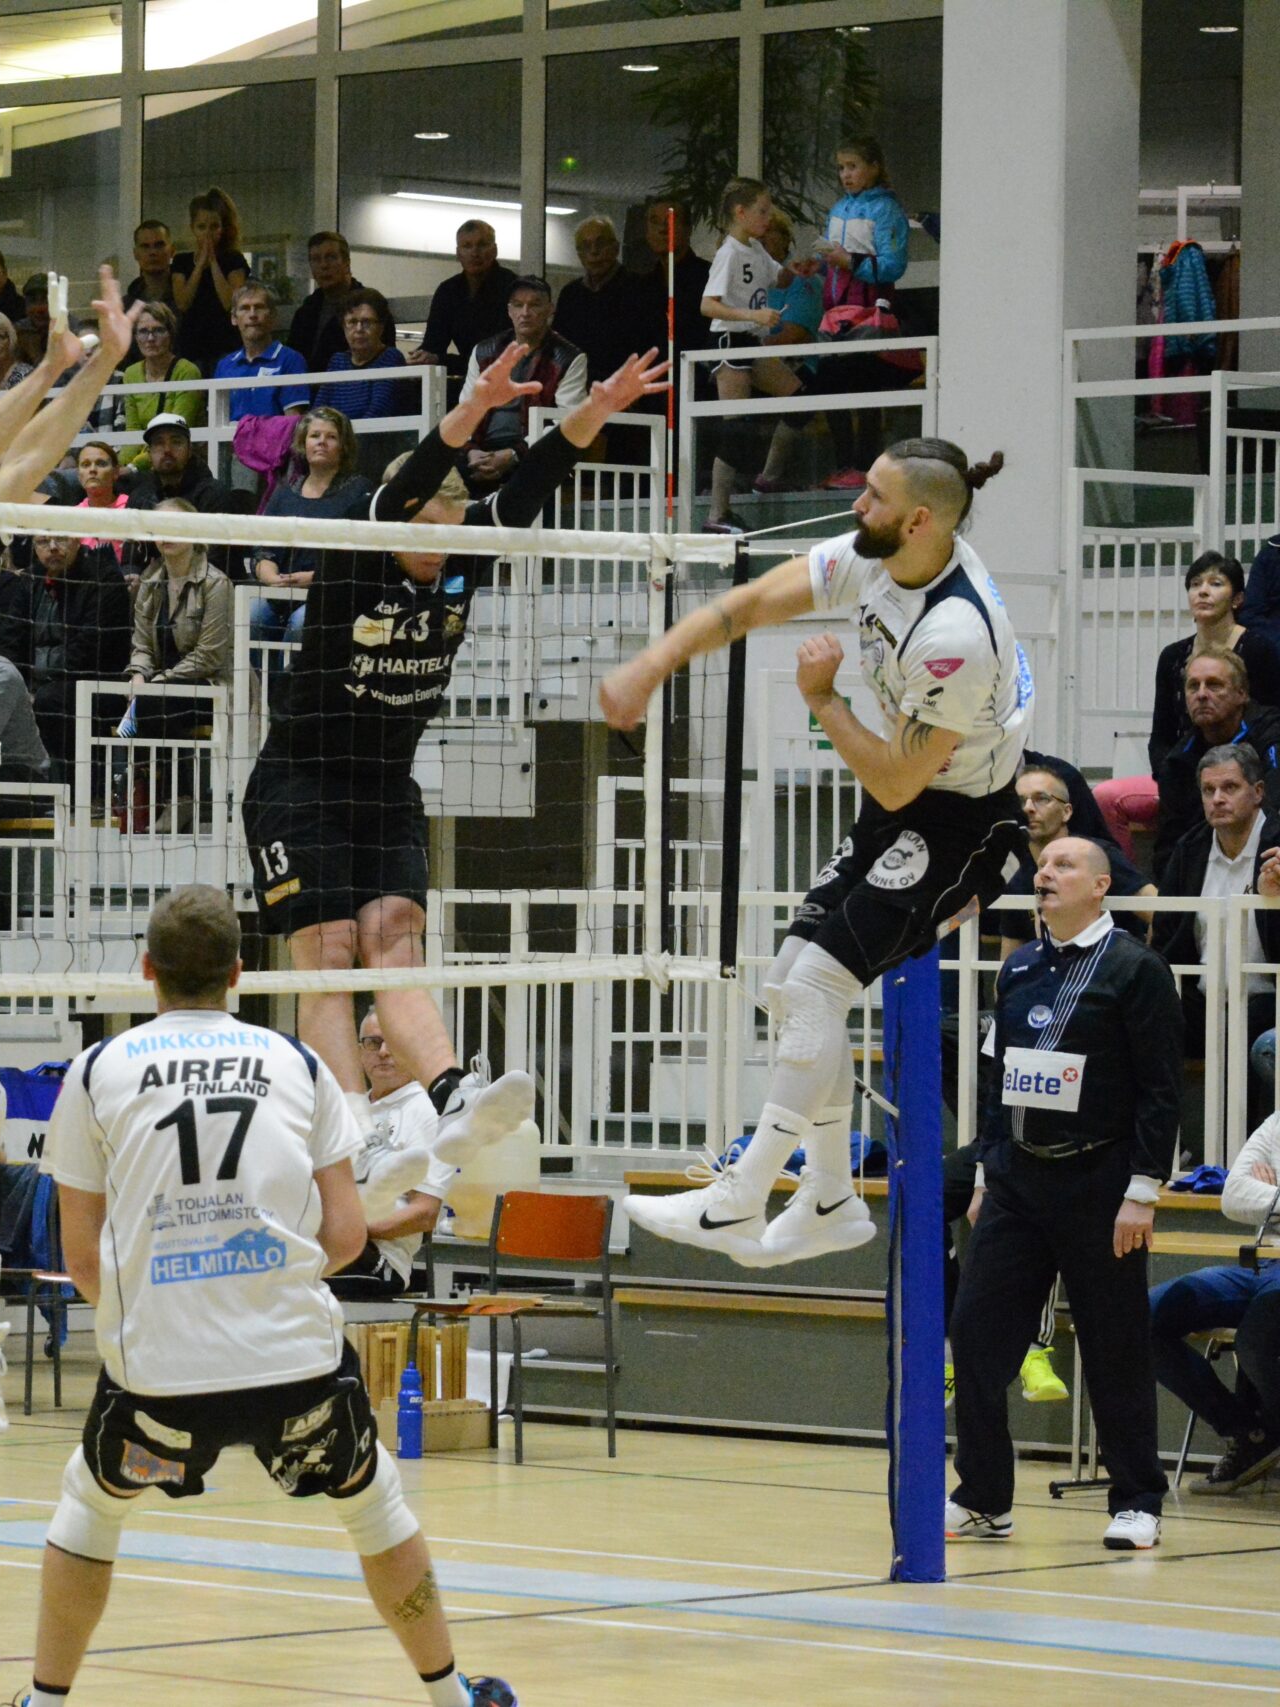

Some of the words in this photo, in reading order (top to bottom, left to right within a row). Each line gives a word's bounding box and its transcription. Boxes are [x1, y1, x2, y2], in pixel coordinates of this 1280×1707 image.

[742, 263, 753, 284] 5
[260, 840, 289, 882] 13
[125, 1030, 270, 1059] MIKKONEN
[137, 1055, 272, 1096] AIRFIL
[183, 1080, 269, 1098] FINLAND
[1004, 1067, 1062, 1097] elete
[154, 1096, 259, 1185] 17
[176, 1192, 245, 1212] TOIJALAN
[153, 1246, 284, 1282] HELMITALO
